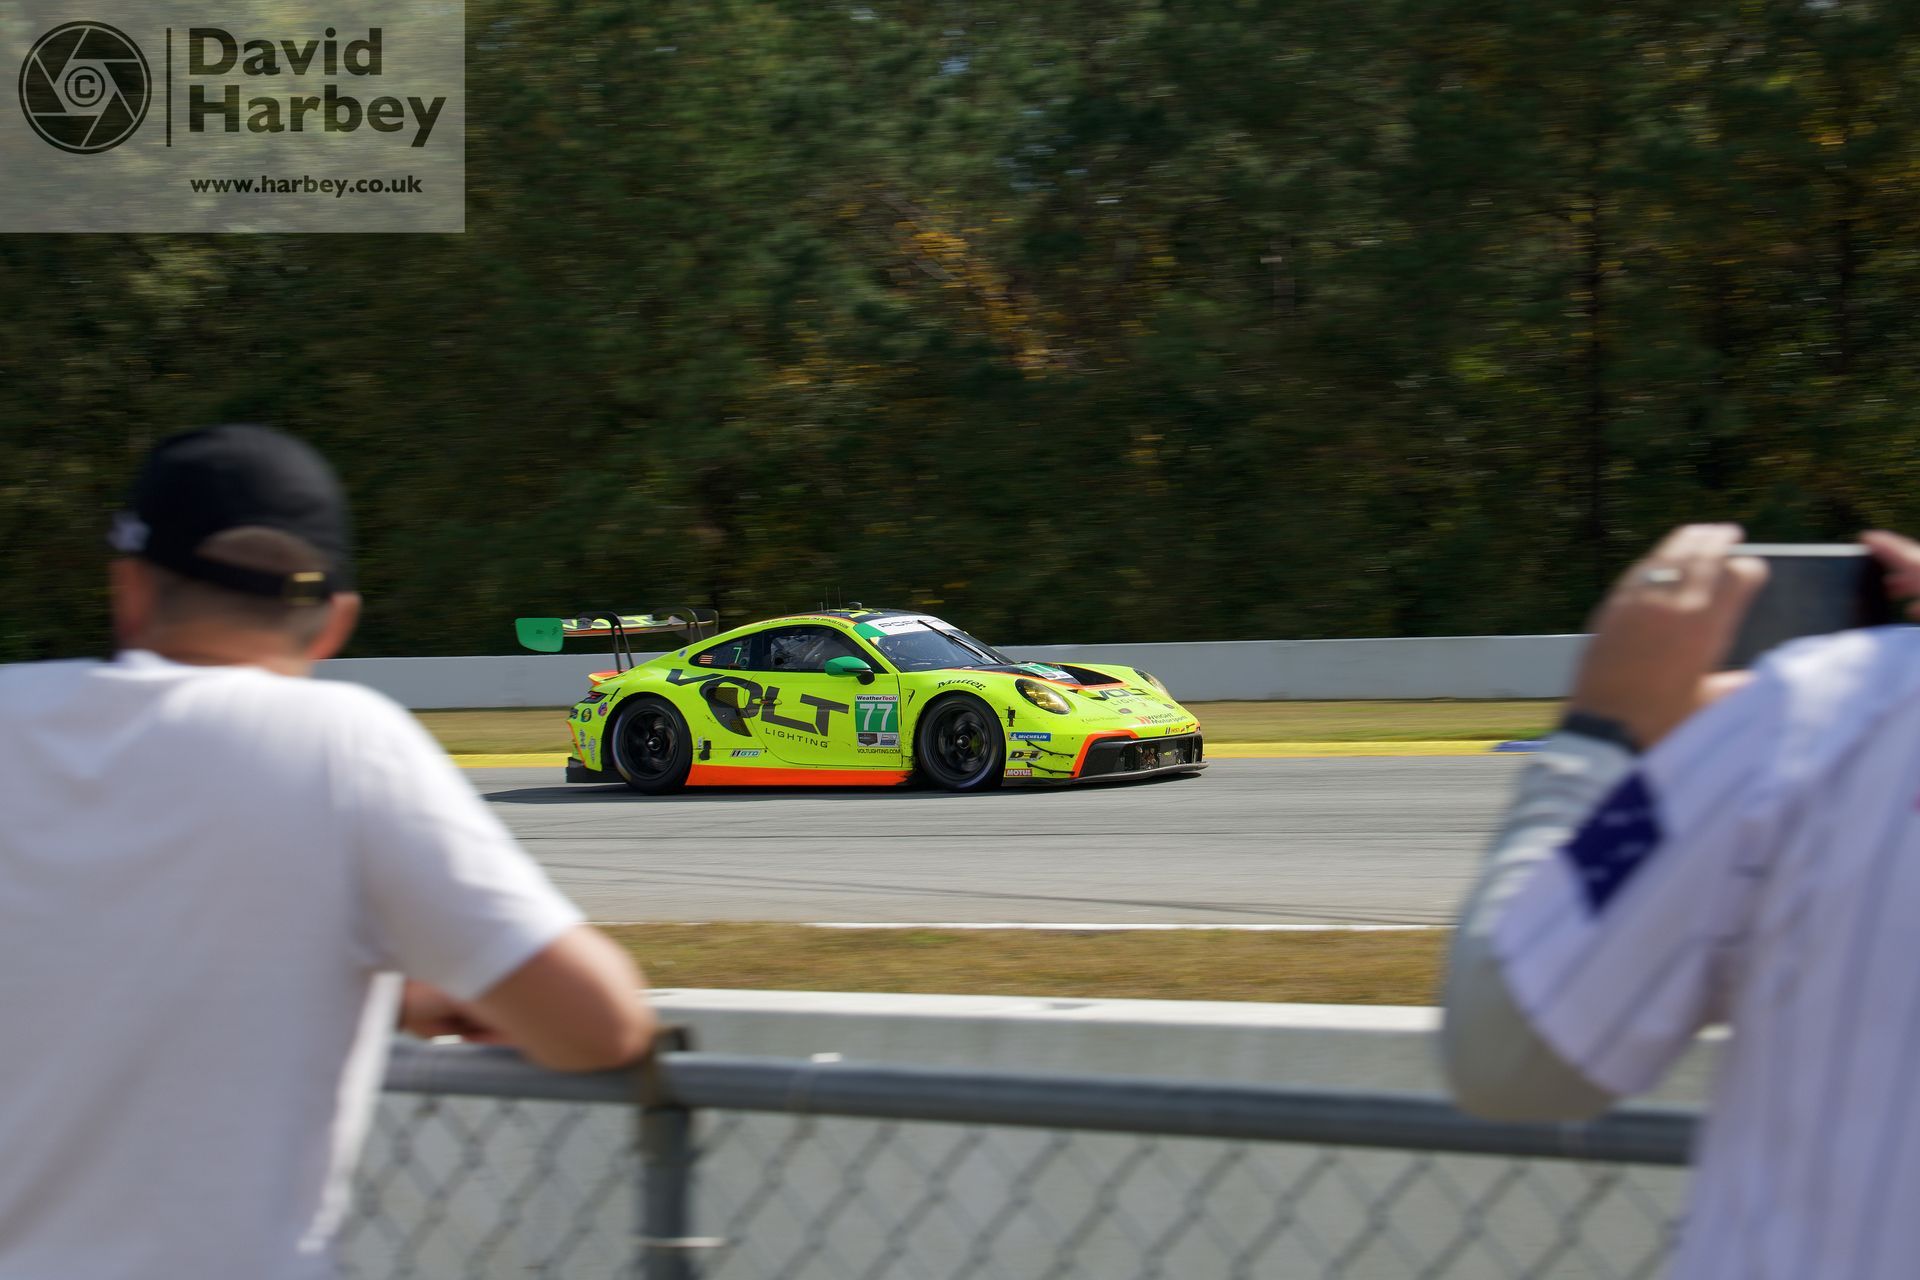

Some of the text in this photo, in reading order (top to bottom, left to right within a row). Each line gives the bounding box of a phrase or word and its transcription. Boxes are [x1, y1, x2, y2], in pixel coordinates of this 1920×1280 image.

[666, 668, 850, 738] VOLT
[859, 703, 893, 731] 77
[765, 727, 829, 749] LIGHTING
